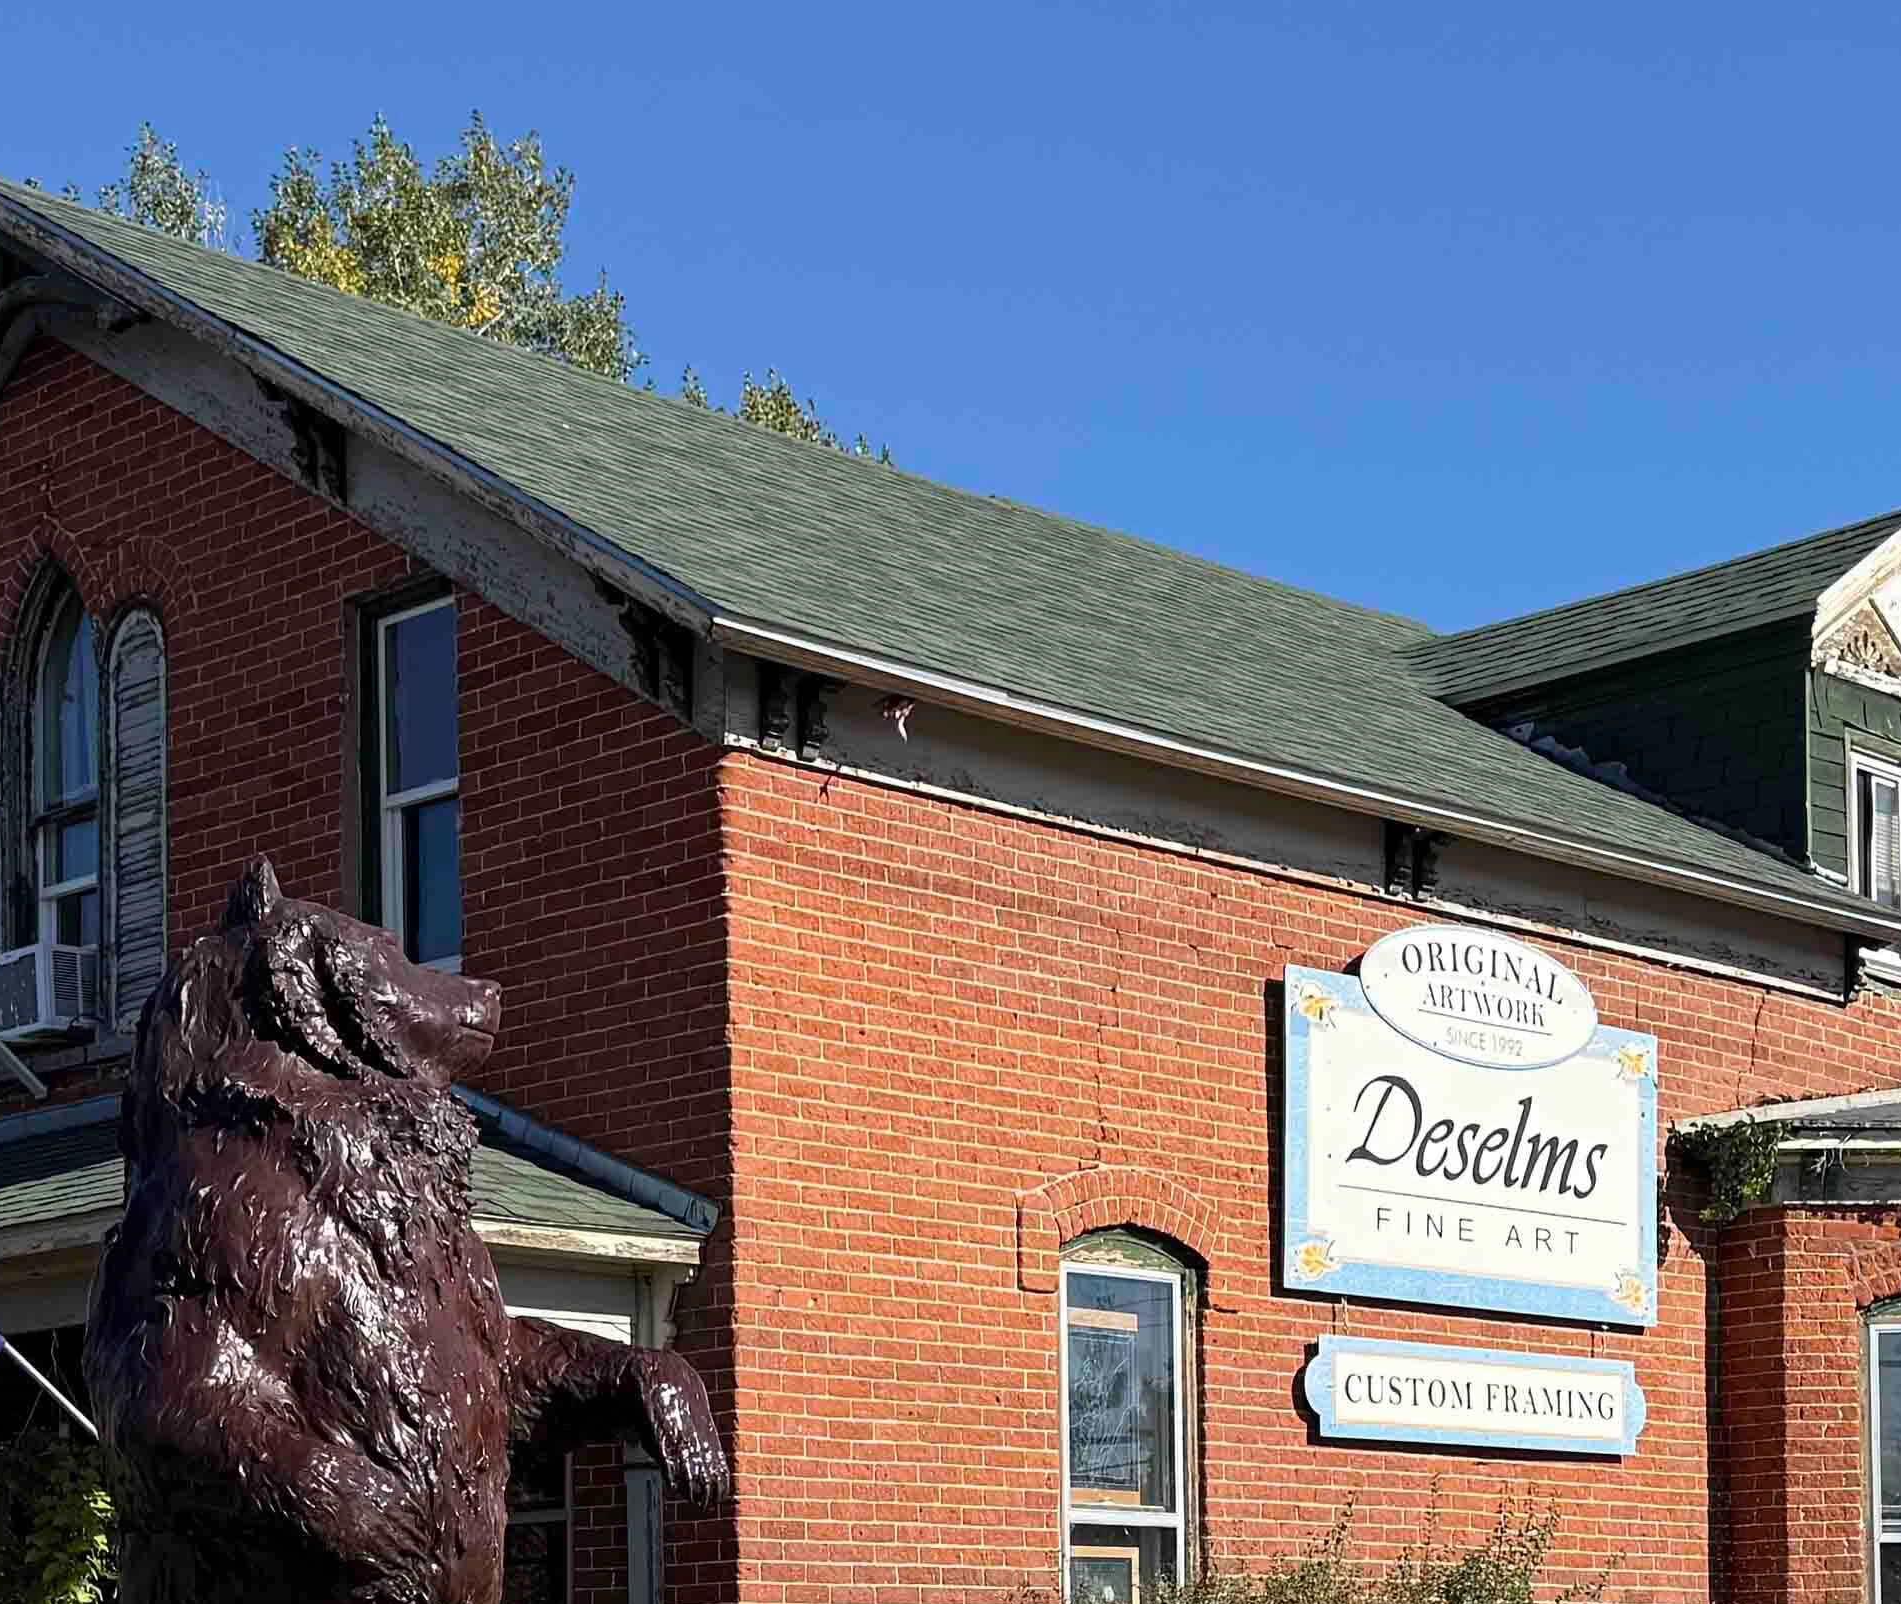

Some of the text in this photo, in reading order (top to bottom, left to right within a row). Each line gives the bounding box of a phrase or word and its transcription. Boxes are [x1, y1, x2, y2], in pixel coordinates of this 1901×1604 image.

[1401, 942, 1563, 1006] ORIGINAL
[1422, 983, 1545, 1028] ARTWORK
[1446, 1026, 1524, 1057] SINCE 1992
[1345, 1074, 1609, 1199] Deselms
[1376, 1206, 1580, 1255] FINE ART
[1344, 1373, 1615, 1421] CUSTOM FRAMING
